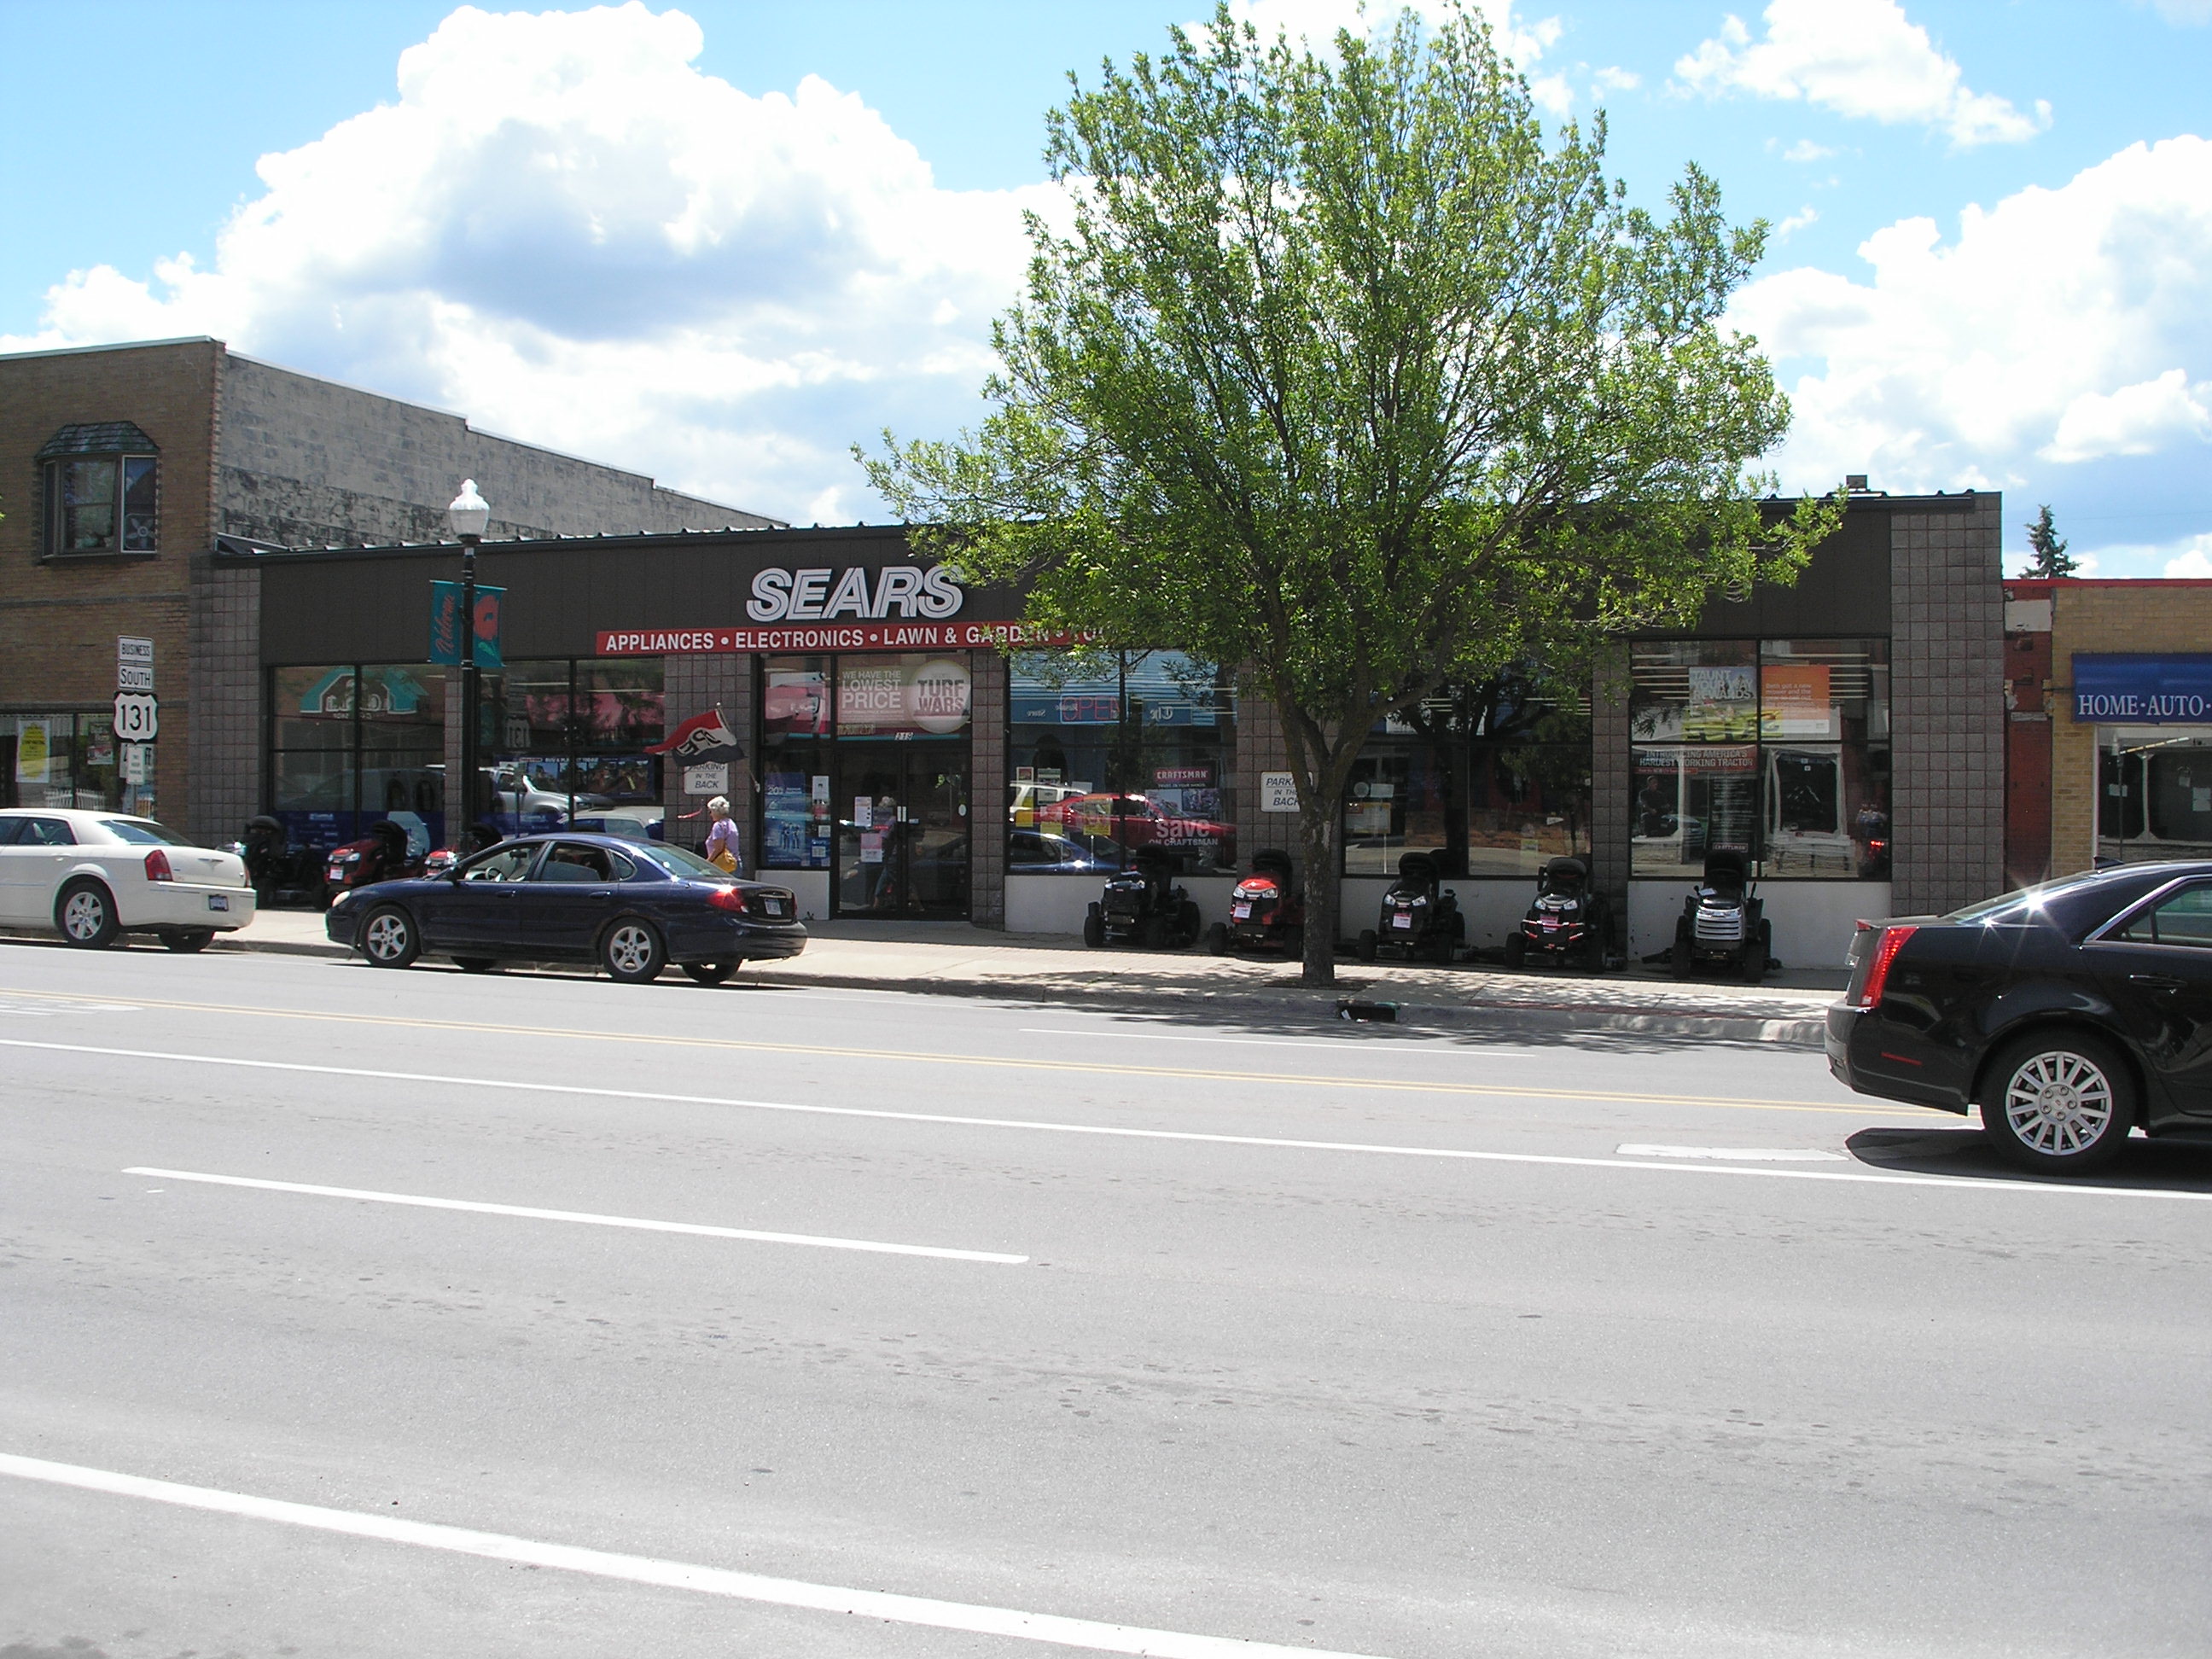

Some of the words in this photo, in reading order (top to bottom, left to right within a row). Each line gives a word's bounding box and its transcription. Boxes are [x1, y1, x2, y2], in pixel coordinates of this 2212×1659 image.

[745, 565, 963, 623] SEARS
[605, 632, 715, 651] APPLIANCES
[735, 629, 864, 649] ELECTRONICS
[883, 627, 938, 645] LAWN
[945, 626, 958, 644] &
[121, 643, 150, 657] BUSINESS
[120, 668, 151, 686] SOUTH
[842, 670, 857, 679] WE
[858, 670, 882, 679] HAVE
[883, 670, 901, 679] THE
[1693, 669, 1732, 681] TAUNT
[842, 679, 901, 692] LOWEST
[917, 678, 965, 697] TURF
[841, 691, 901, 709] PRICE
[917, 696, 965, 713] WARS
[2077, 695, 2139, 716] HOME
[2145, 695, 2204, 716] AUTO
[1062, 696, 1121, 721] OPEN
[120, 704, 151, 732] 131
[1703, 749, 1748, 758] AMERICA'S
[691, 762, 725, 771] ARKING
[1639, 758, 1675, 766] HARDEST
[1717, 758, 1754, 767] TRACTOR
[1156, 771, 1207, 779] CRAFTSMAN
[1266, 777, 1295, 786] PARK
[695, 780, 719, 789] BACK
[1156, 819, 1210, 838] save
[1164, 837, 1219, 847] CRAFTSMAN
